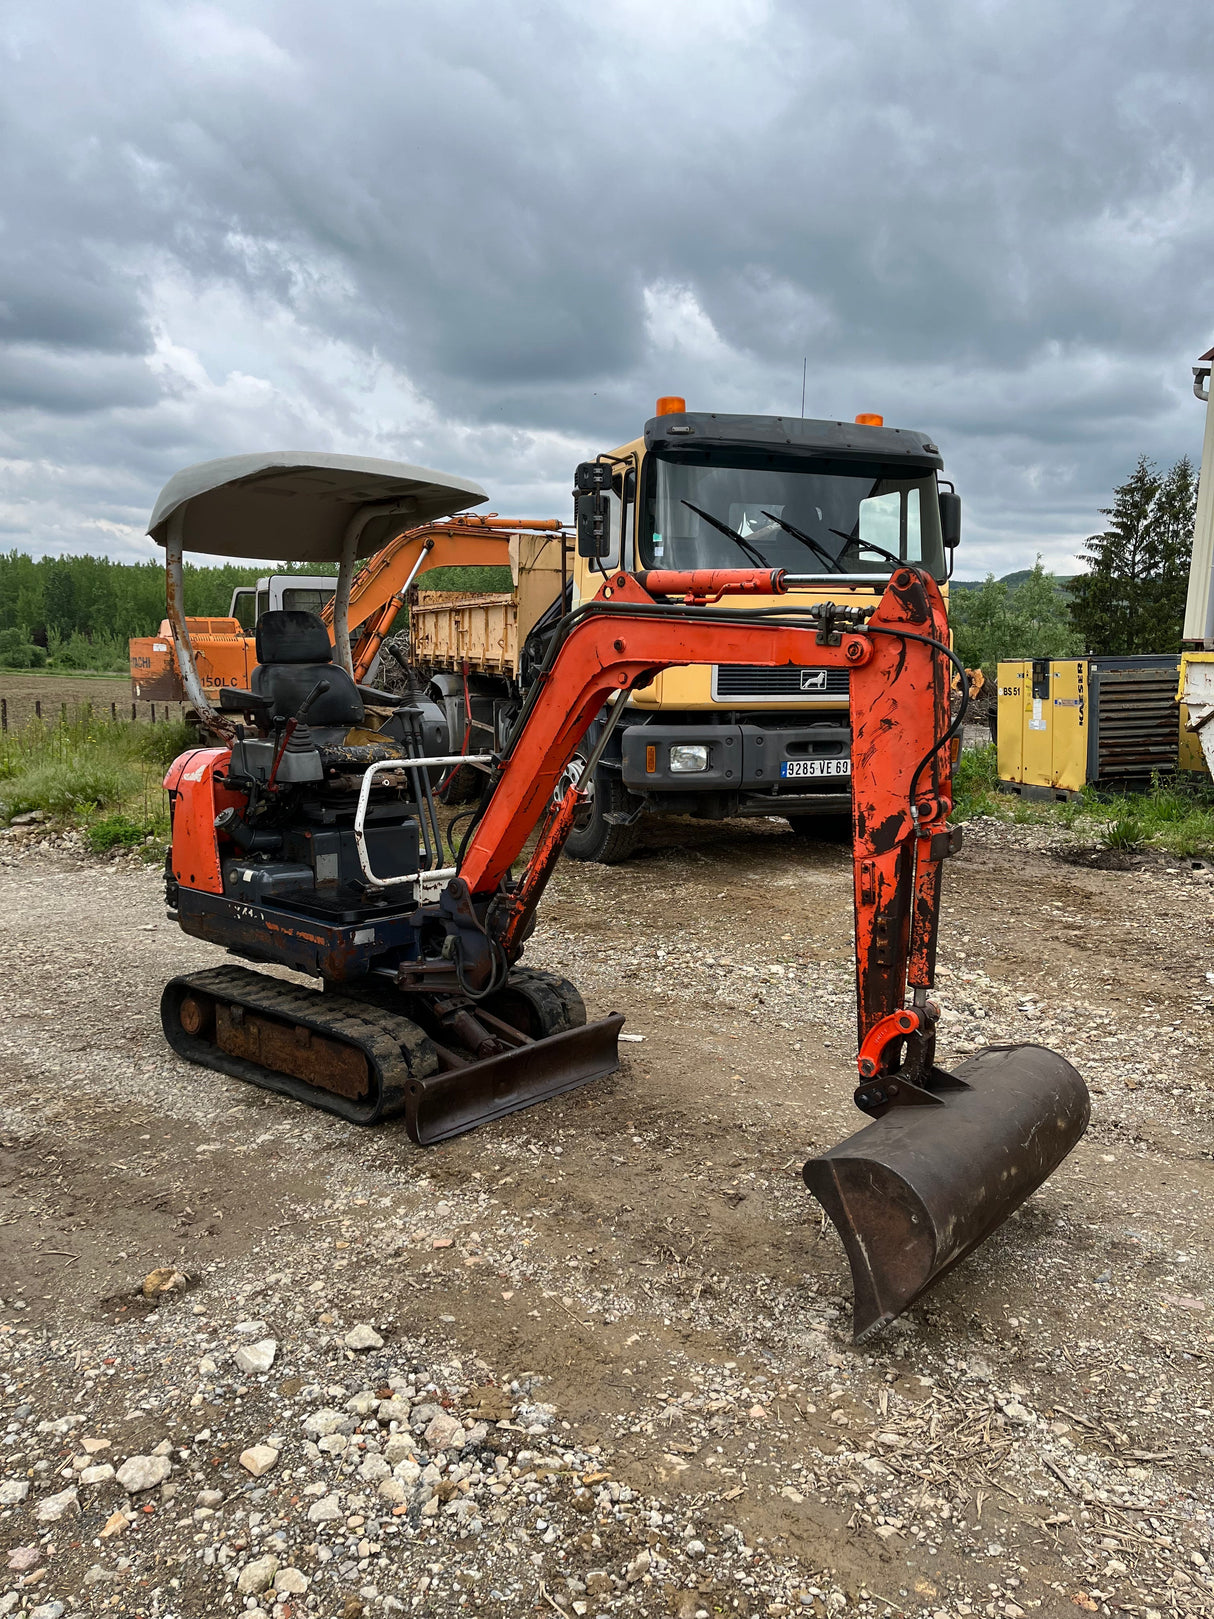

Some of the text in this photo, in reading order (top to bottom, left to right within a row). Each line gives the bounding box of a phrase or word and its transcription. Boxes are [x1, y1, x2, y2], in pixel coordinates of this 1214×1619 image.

[1003, 687, 1020, 696] BS 51
[788, 763, 815, 776] 9285
[819, 762, 832, 774] VE
